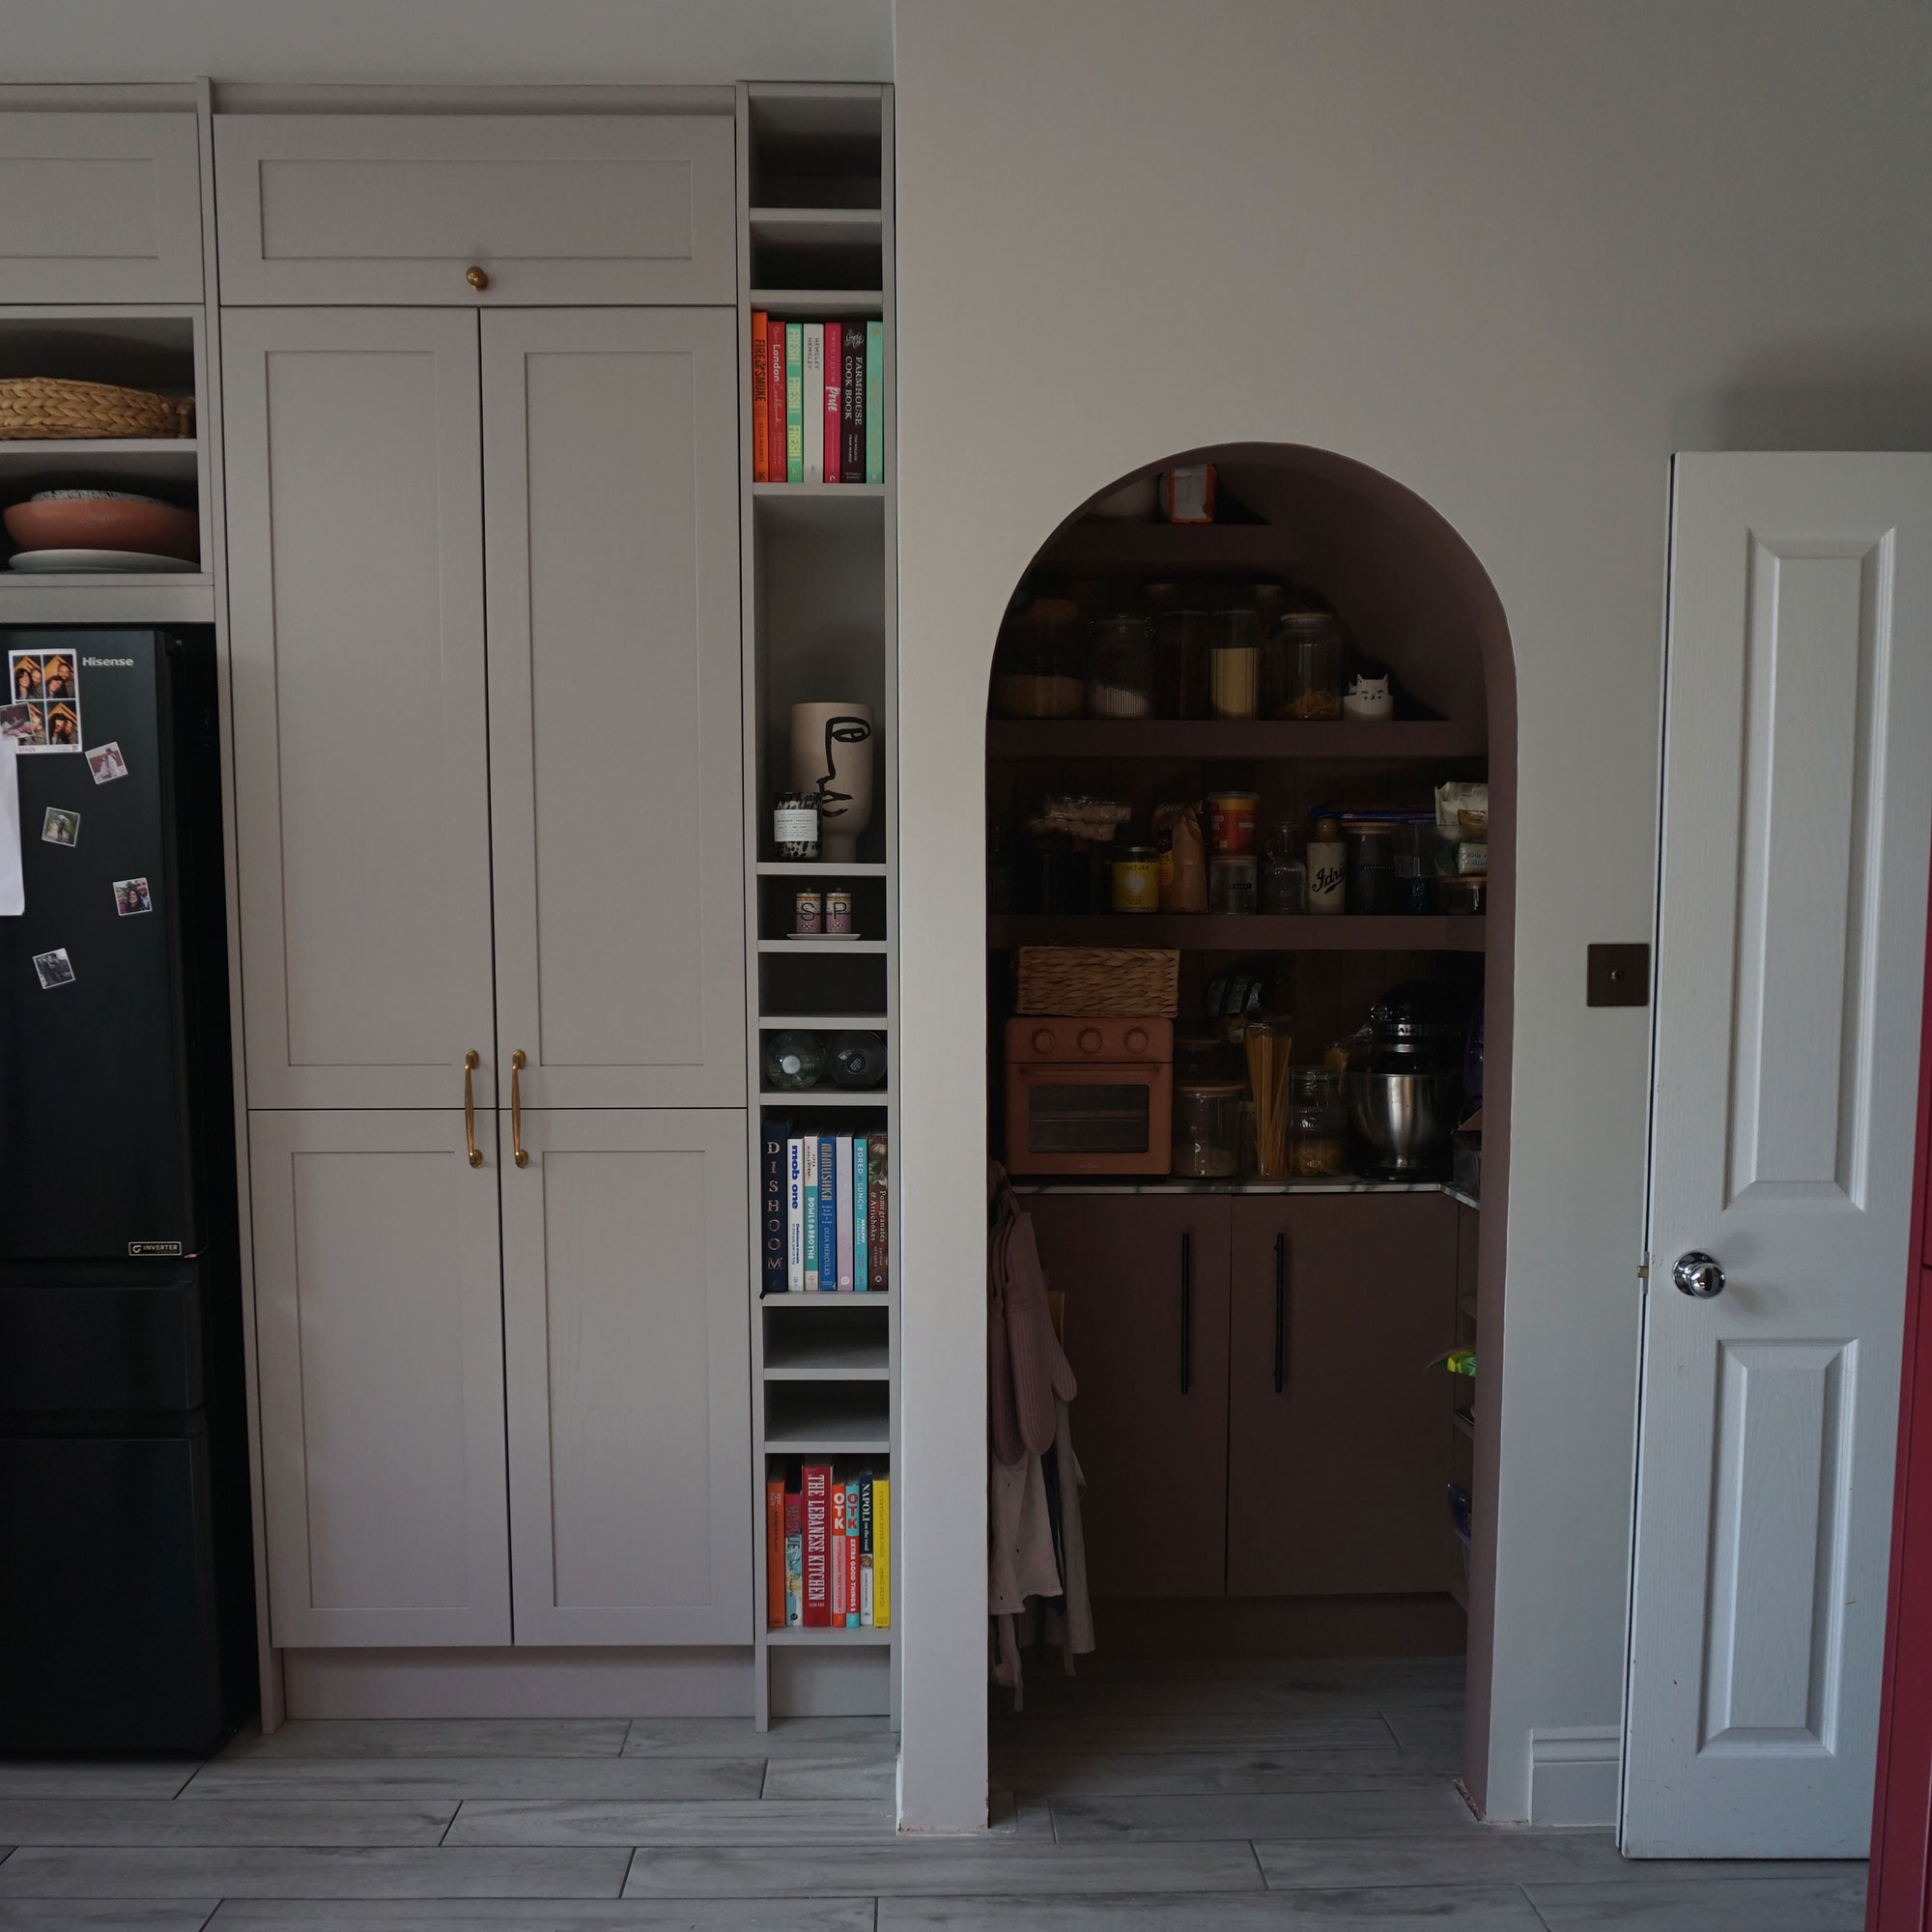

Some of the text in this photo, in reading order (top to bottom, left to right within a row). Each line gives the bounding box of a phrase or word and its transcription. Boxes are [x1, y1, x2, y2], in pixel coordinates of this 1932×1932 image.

[788, 328, 800, 462] FRESH! FRESH! FRESH!
[825, 386, 840, 412] Prue
[854, 355, 863, 425] FARMHOUSE
[81, 656, 134, 668] Hisense
[801, 902, 814, 922] S
[833, 901, 846, 920] P
[821, 1143, 832, 1201] MAMUSHKA
[766, 1142, 783, 1270] DISHOOM
[808, 1475, 824, 1495] THE
[808, 1501, 824, 1552] LEBANESE
[834, 1492, 844, 1530] OTK
[848, 1493, 858, 1529] OTK
[809, 1555, 825, 1601] KITCHEN
